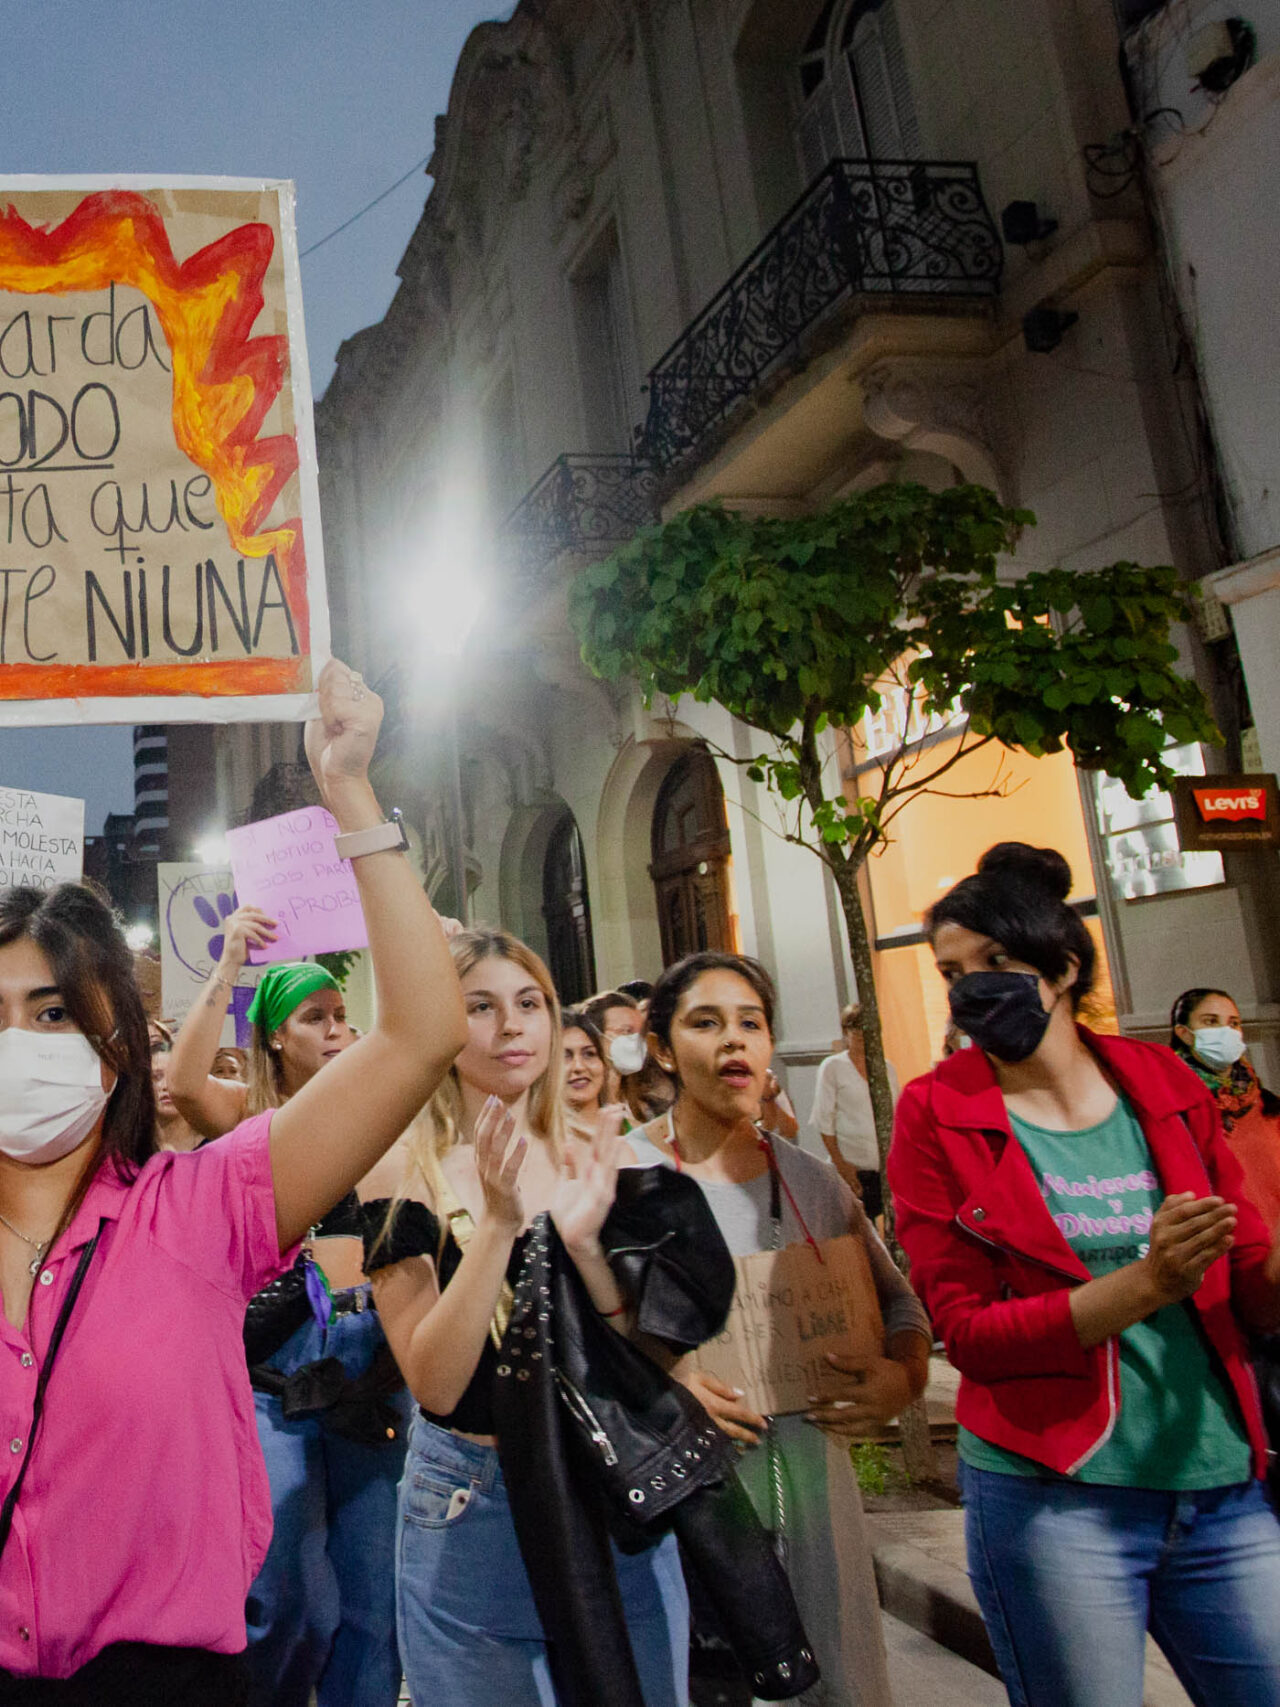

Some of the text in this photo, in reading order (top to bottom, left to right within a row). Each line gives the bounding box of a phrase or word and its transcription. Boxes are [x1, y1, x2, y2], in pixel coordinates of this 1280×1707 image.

[90, 475, 215, 564] que
[278, 814, 313, 836] NO
[3, 830, 78, 855] MOLESTA
[265, 841, 324, 864] MOTIVO
[10, 850, 56, 873] HACIA
[1042, 1170, 1158, 1198] Mujeres
